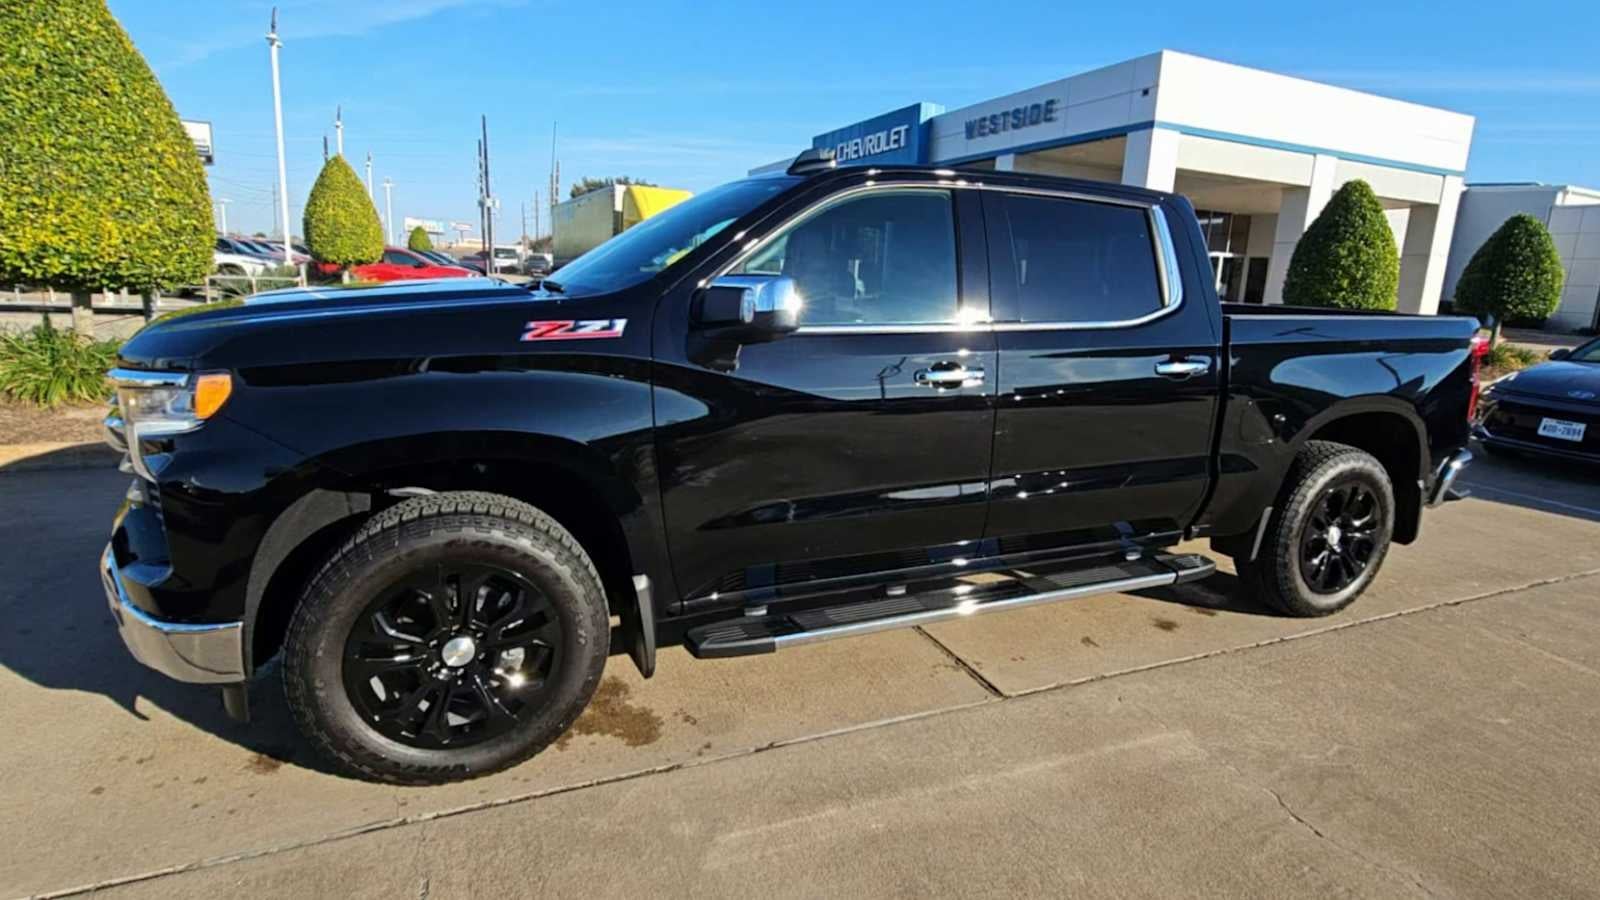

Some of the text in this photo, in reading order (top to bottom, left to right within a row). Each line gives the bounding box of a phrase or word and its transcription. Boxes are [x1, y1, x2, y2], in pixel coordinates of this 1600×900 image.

[964, 99, 1060, 140] WESTSIDE
[836, 124, 909, 163] CHEVROLET
[520, 318, 628, 341] Z71
